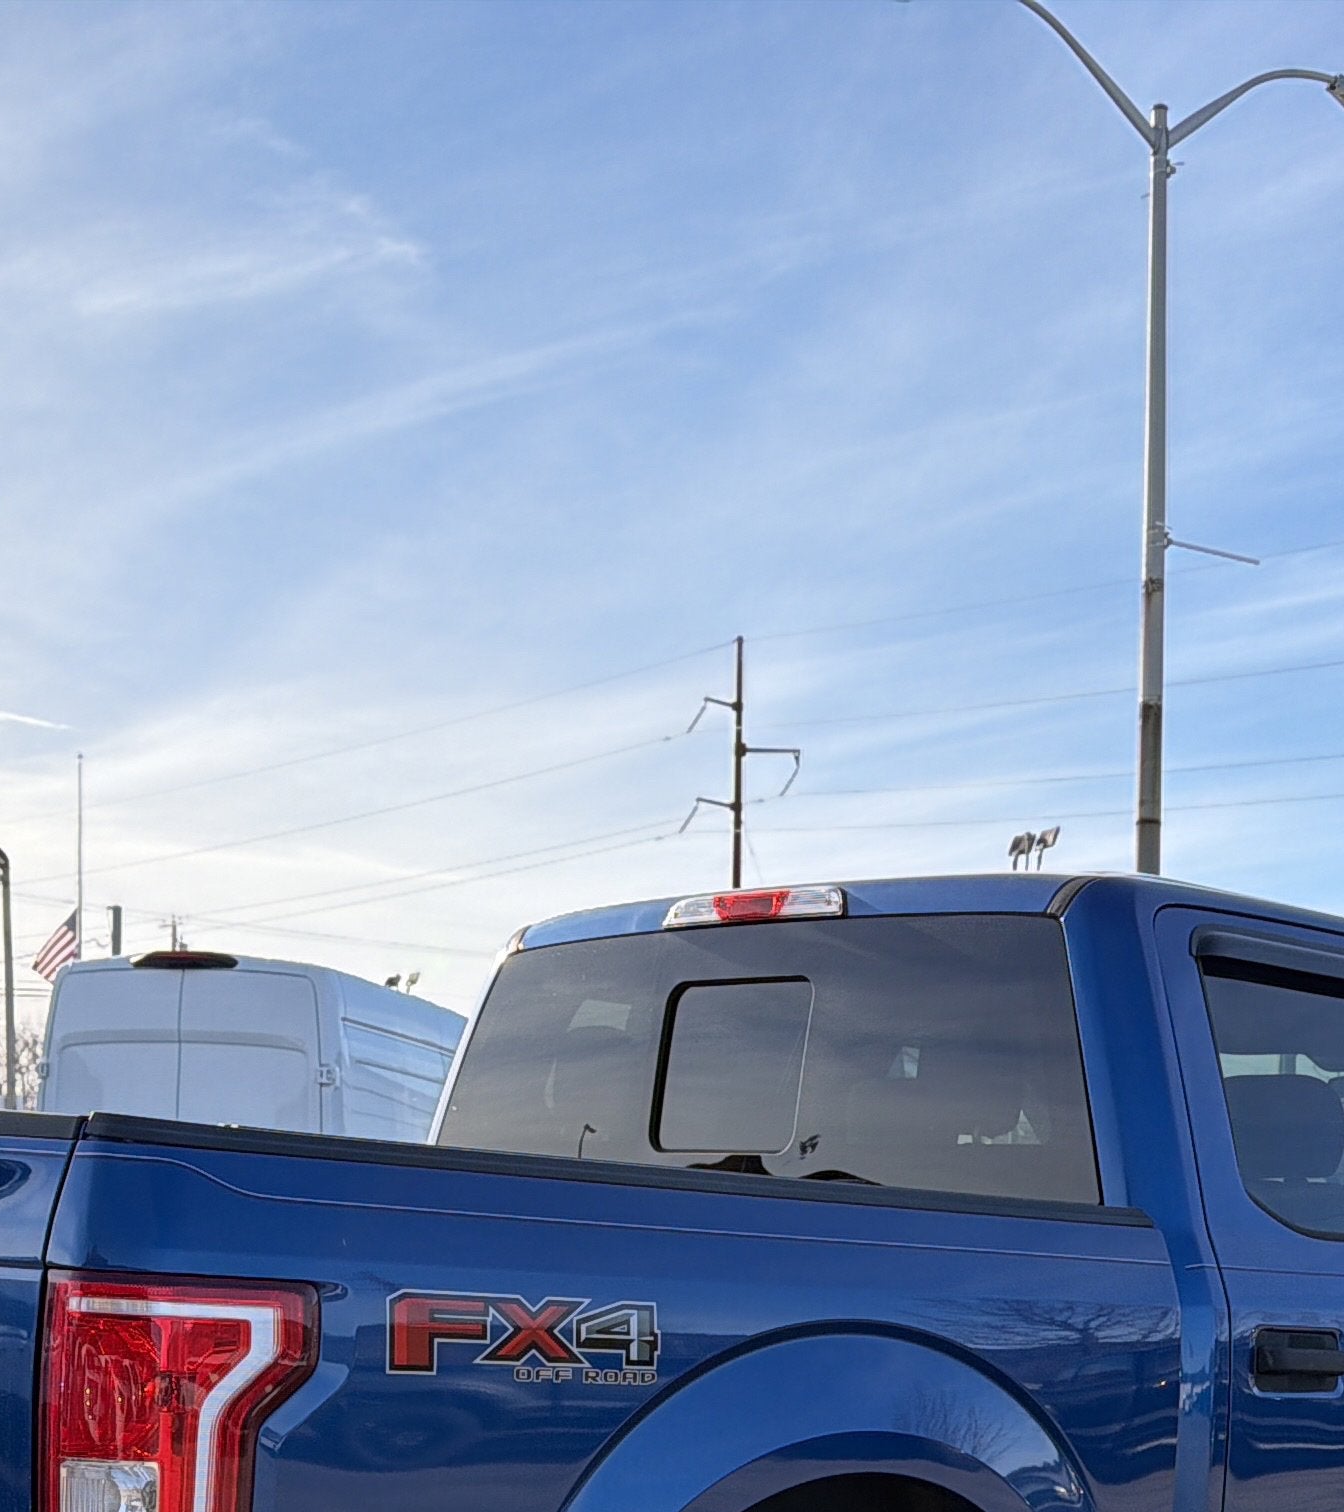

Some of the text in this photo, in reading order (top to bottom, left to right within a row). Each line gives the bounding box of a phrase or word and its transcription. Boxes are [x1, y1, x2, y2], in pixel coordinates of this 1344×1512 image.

[386, 1288, 661, 1376] FX4
[513, 1366, 657, 1386] OFF ROAD
